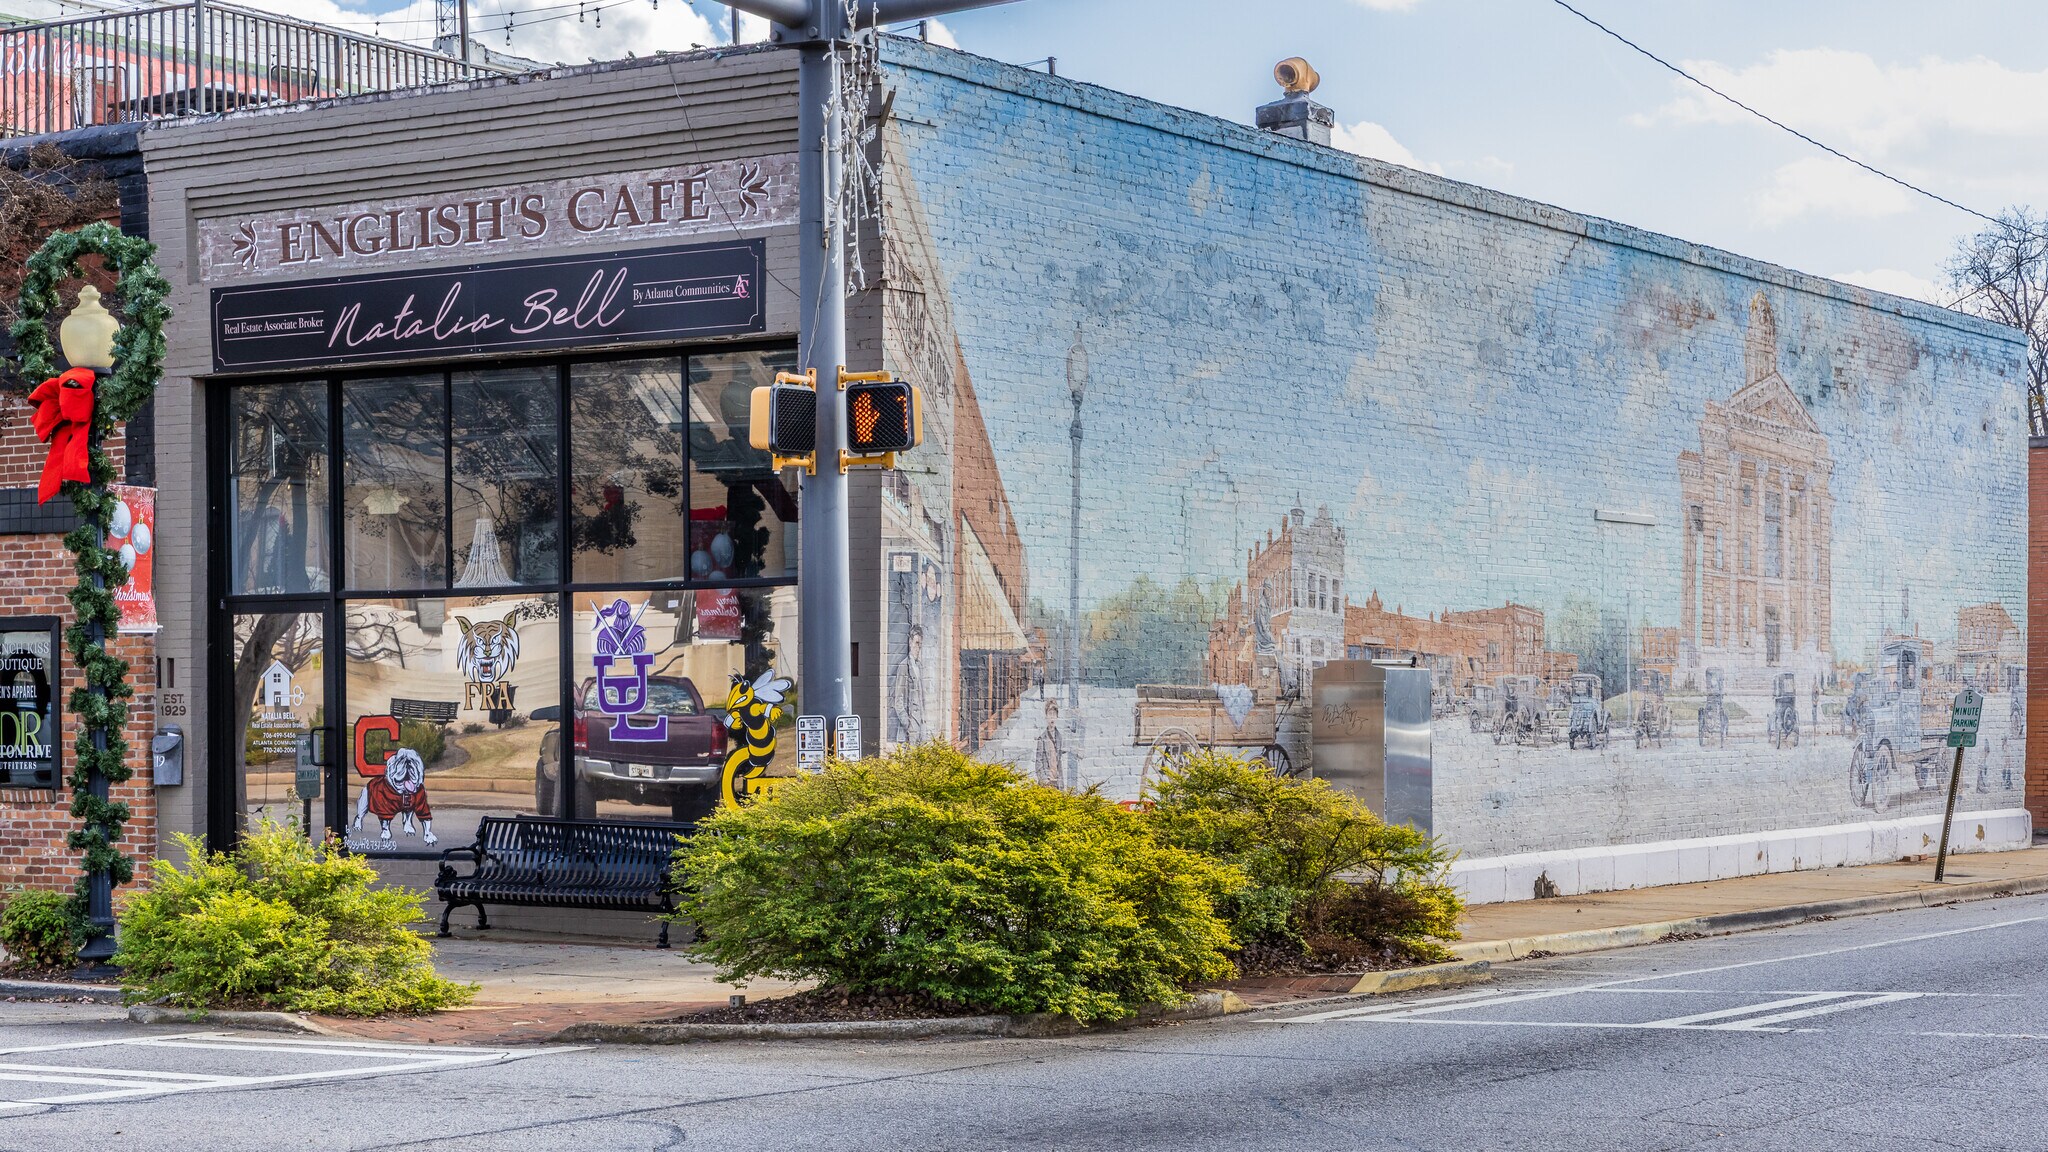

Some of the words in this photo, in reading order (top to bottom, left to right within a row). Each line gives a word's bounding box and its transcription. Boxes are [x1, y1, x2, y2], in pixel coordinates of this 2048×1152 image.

[277, 193, 548, 266] ENGLISH'S
[567, 168, 712, 234] CAFÉ
[633, 289, 643, 303] By
[645, 287, 673, 300] Atlanta
[675, 282, 730, 297] Communities
[328, 281, 505, 348] Natalia
[510, 266, 628, 334] Bell
[224, 323, 240, 335] Real
[241, 321, 262, 334] Estate
[264, 319, 297, 332] Associate
[298, 316, 324, 329] Broker
[112, 587, 151, 601] Christmas
[0, 641, 23, 654] NCH
[27, 641, 49, 654] KISS
[12, 685, 37, 698] APPAREL
[463, 681, 516, 711] FRA
[163, 693, 185, 704] EST.
[1965, 696, 1973, 704] 15
[161, 705, 187, 716] 1929
[261, 712, 282, 720] NATALIA
[1954, 707, 1979, 716] MINUTE
[1953, 719, 1978, 728] PARKING
[354, 715, 400, 778] G
